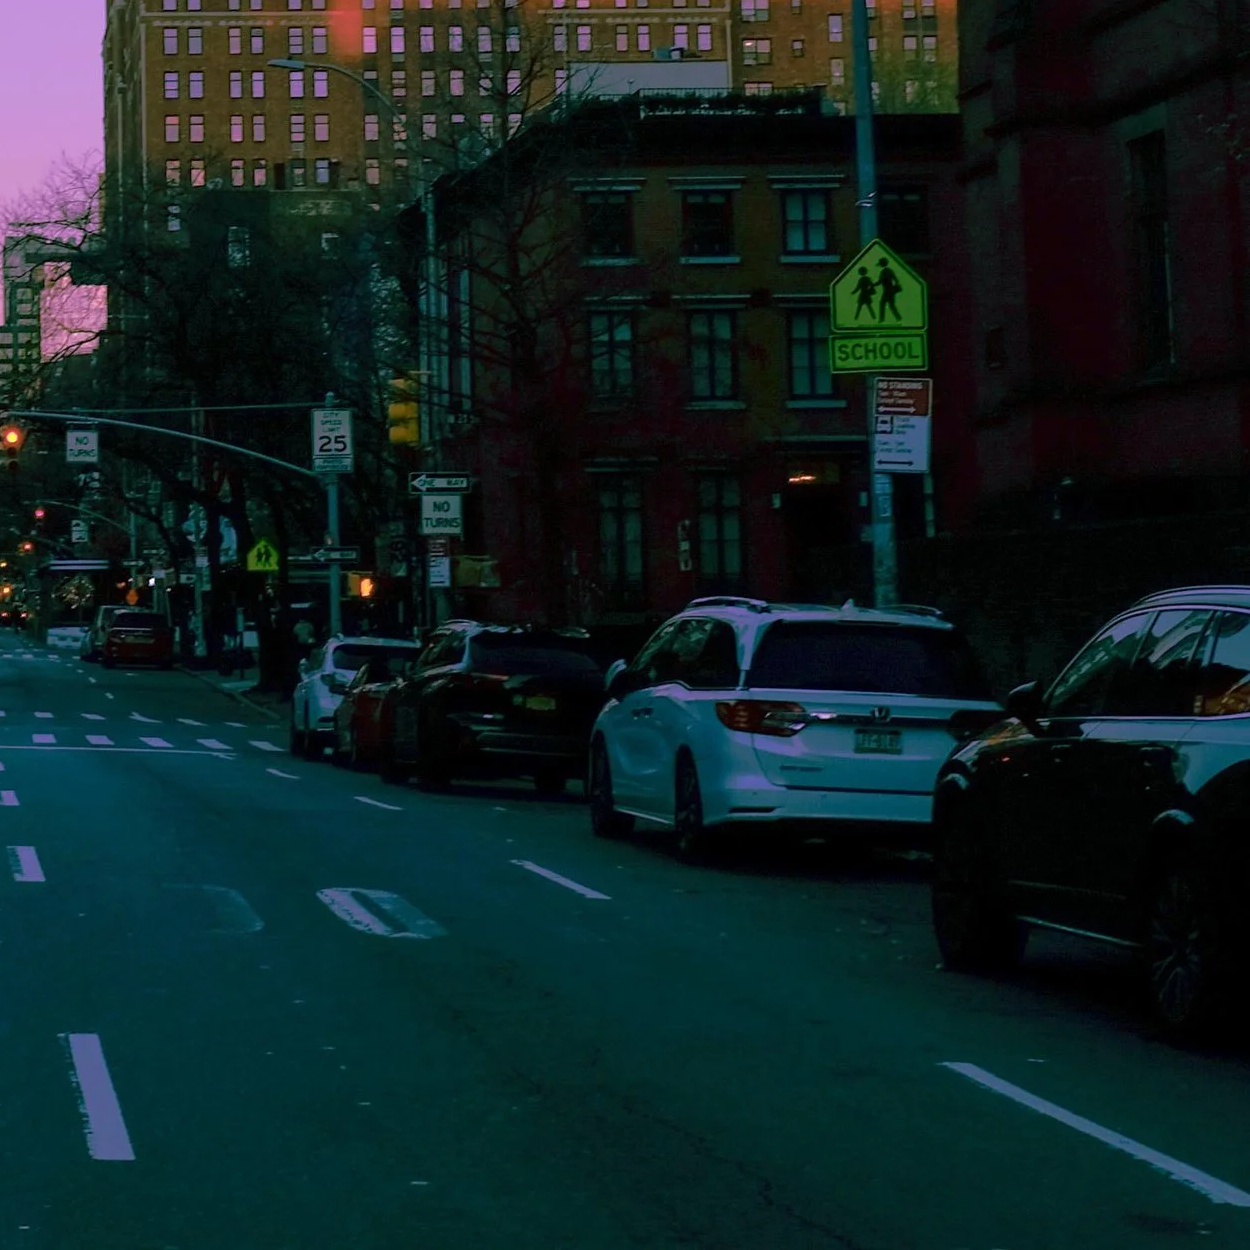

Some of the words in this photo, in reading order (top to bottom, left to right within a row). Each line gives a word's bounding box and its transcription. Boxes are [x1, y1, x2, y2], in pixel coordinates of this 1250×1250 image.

[837, 341, 920, 362] SCHOOL
[76, 436, 88, 445] NO
[319, 435, 347, 452] 25
[69, 449, 96, 457] TURNS
[417, 478, 436, 487] ONE
[446, 478, 465, 487] WAY
[432, 500, 450, 513] NO
[423, 517, 461, 528] TURNS
